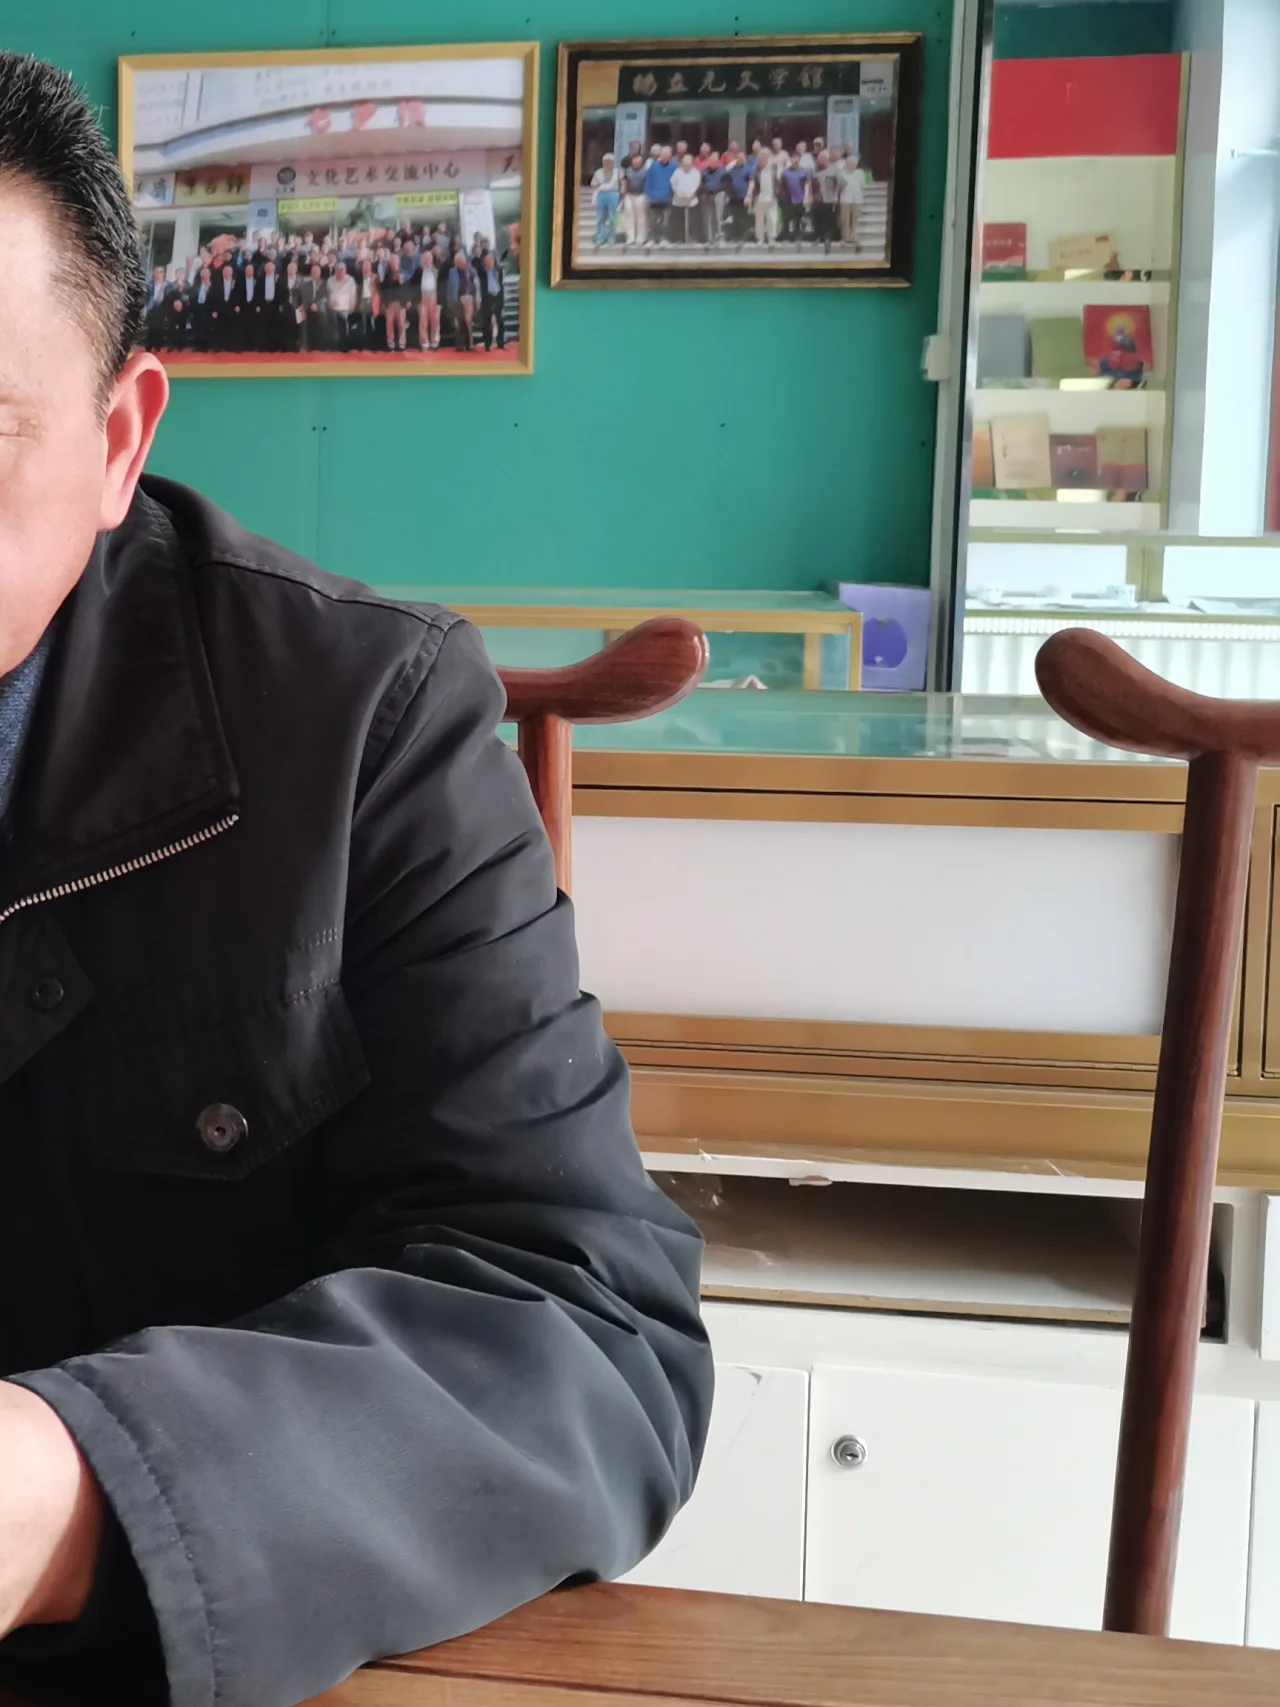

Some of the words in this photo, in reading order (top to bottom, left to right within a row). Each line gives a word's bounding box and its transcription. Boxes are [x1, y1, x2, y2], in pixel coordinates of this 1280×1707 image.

[306, 161, 459, 187] 文化艺术交流中心
